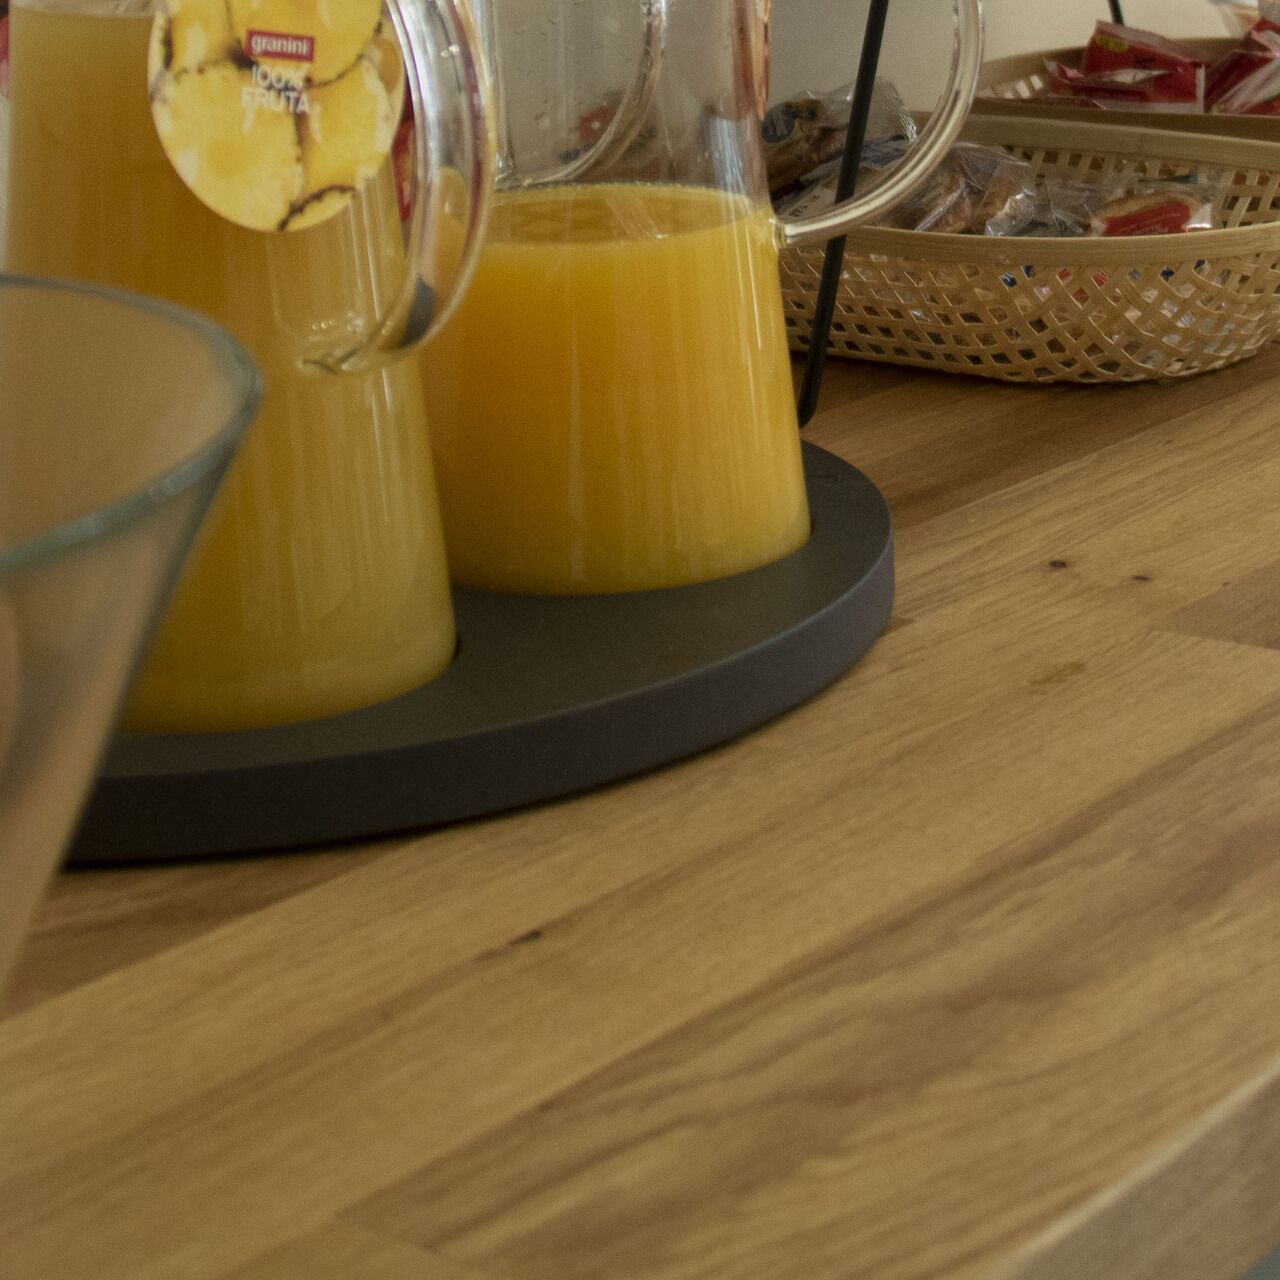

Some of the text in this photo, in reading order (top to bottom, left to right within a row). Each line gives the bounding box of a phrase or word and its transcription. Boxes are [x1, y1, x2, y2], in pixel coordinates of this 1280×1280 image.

[251, 35, 309, 55] granini
[252, 63, 307, 90] 100%
[241, 86, 310, 113] FRUTA
